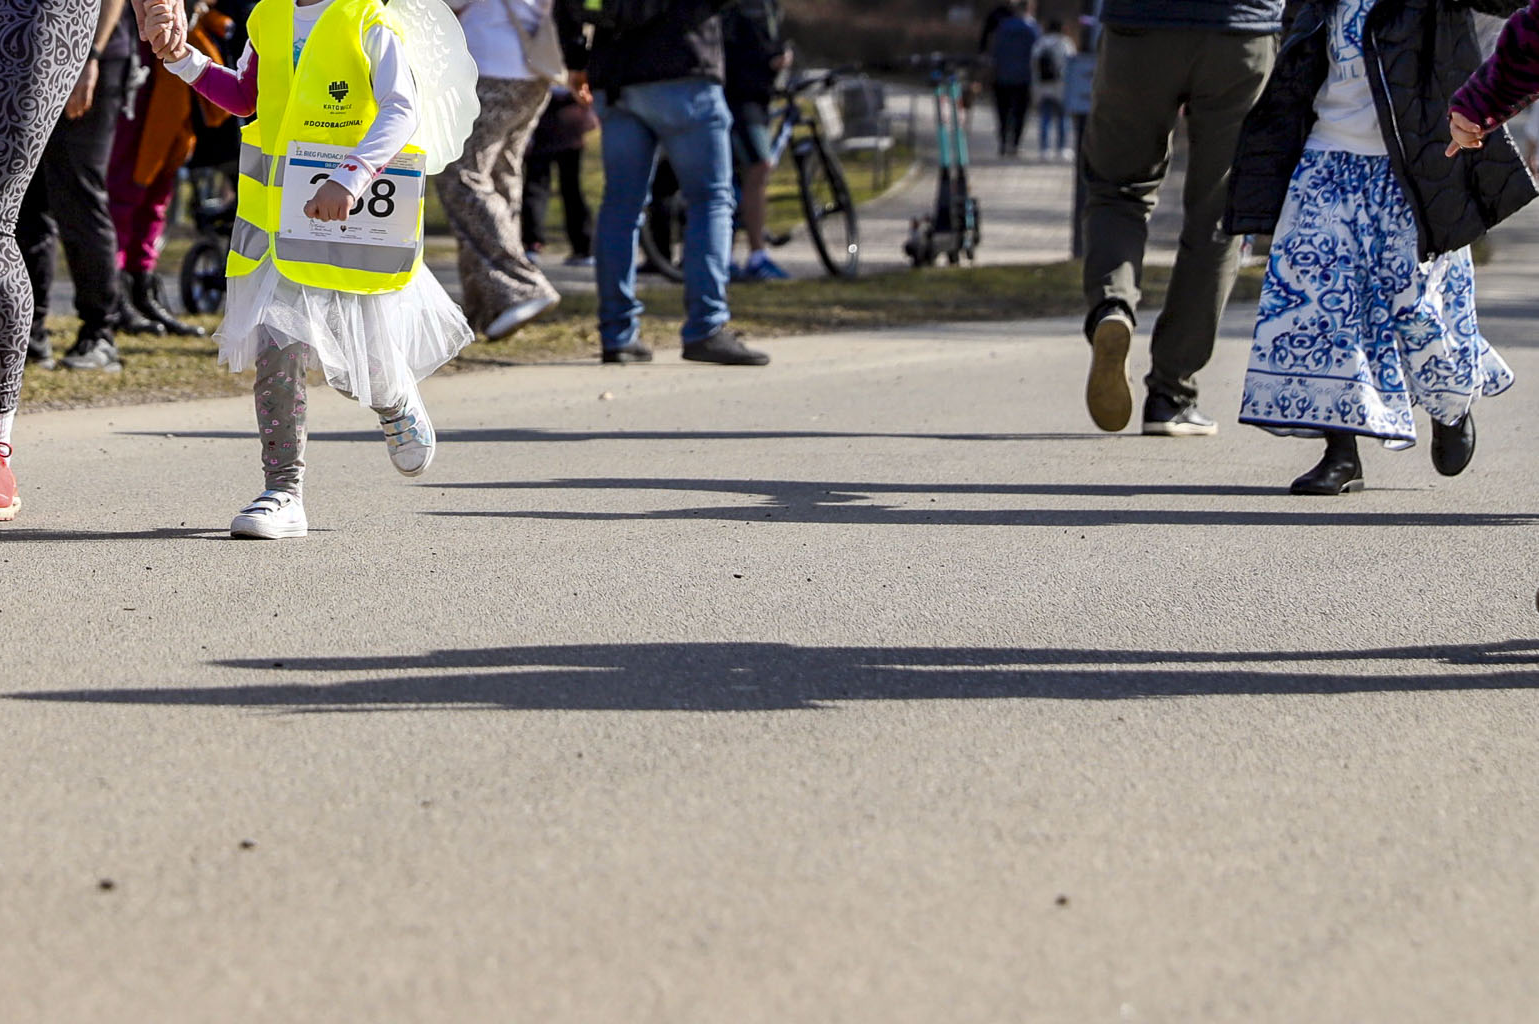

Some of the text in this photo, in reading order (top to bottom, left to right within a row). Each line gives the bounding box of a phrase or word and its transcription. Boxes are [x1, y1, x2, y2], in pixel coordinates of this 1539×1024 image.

[323, 103, 353, 111] KATOWICE
[304, 150, 316, 158] BIEG
[317, 151, 344, 160] FUNDACJI
